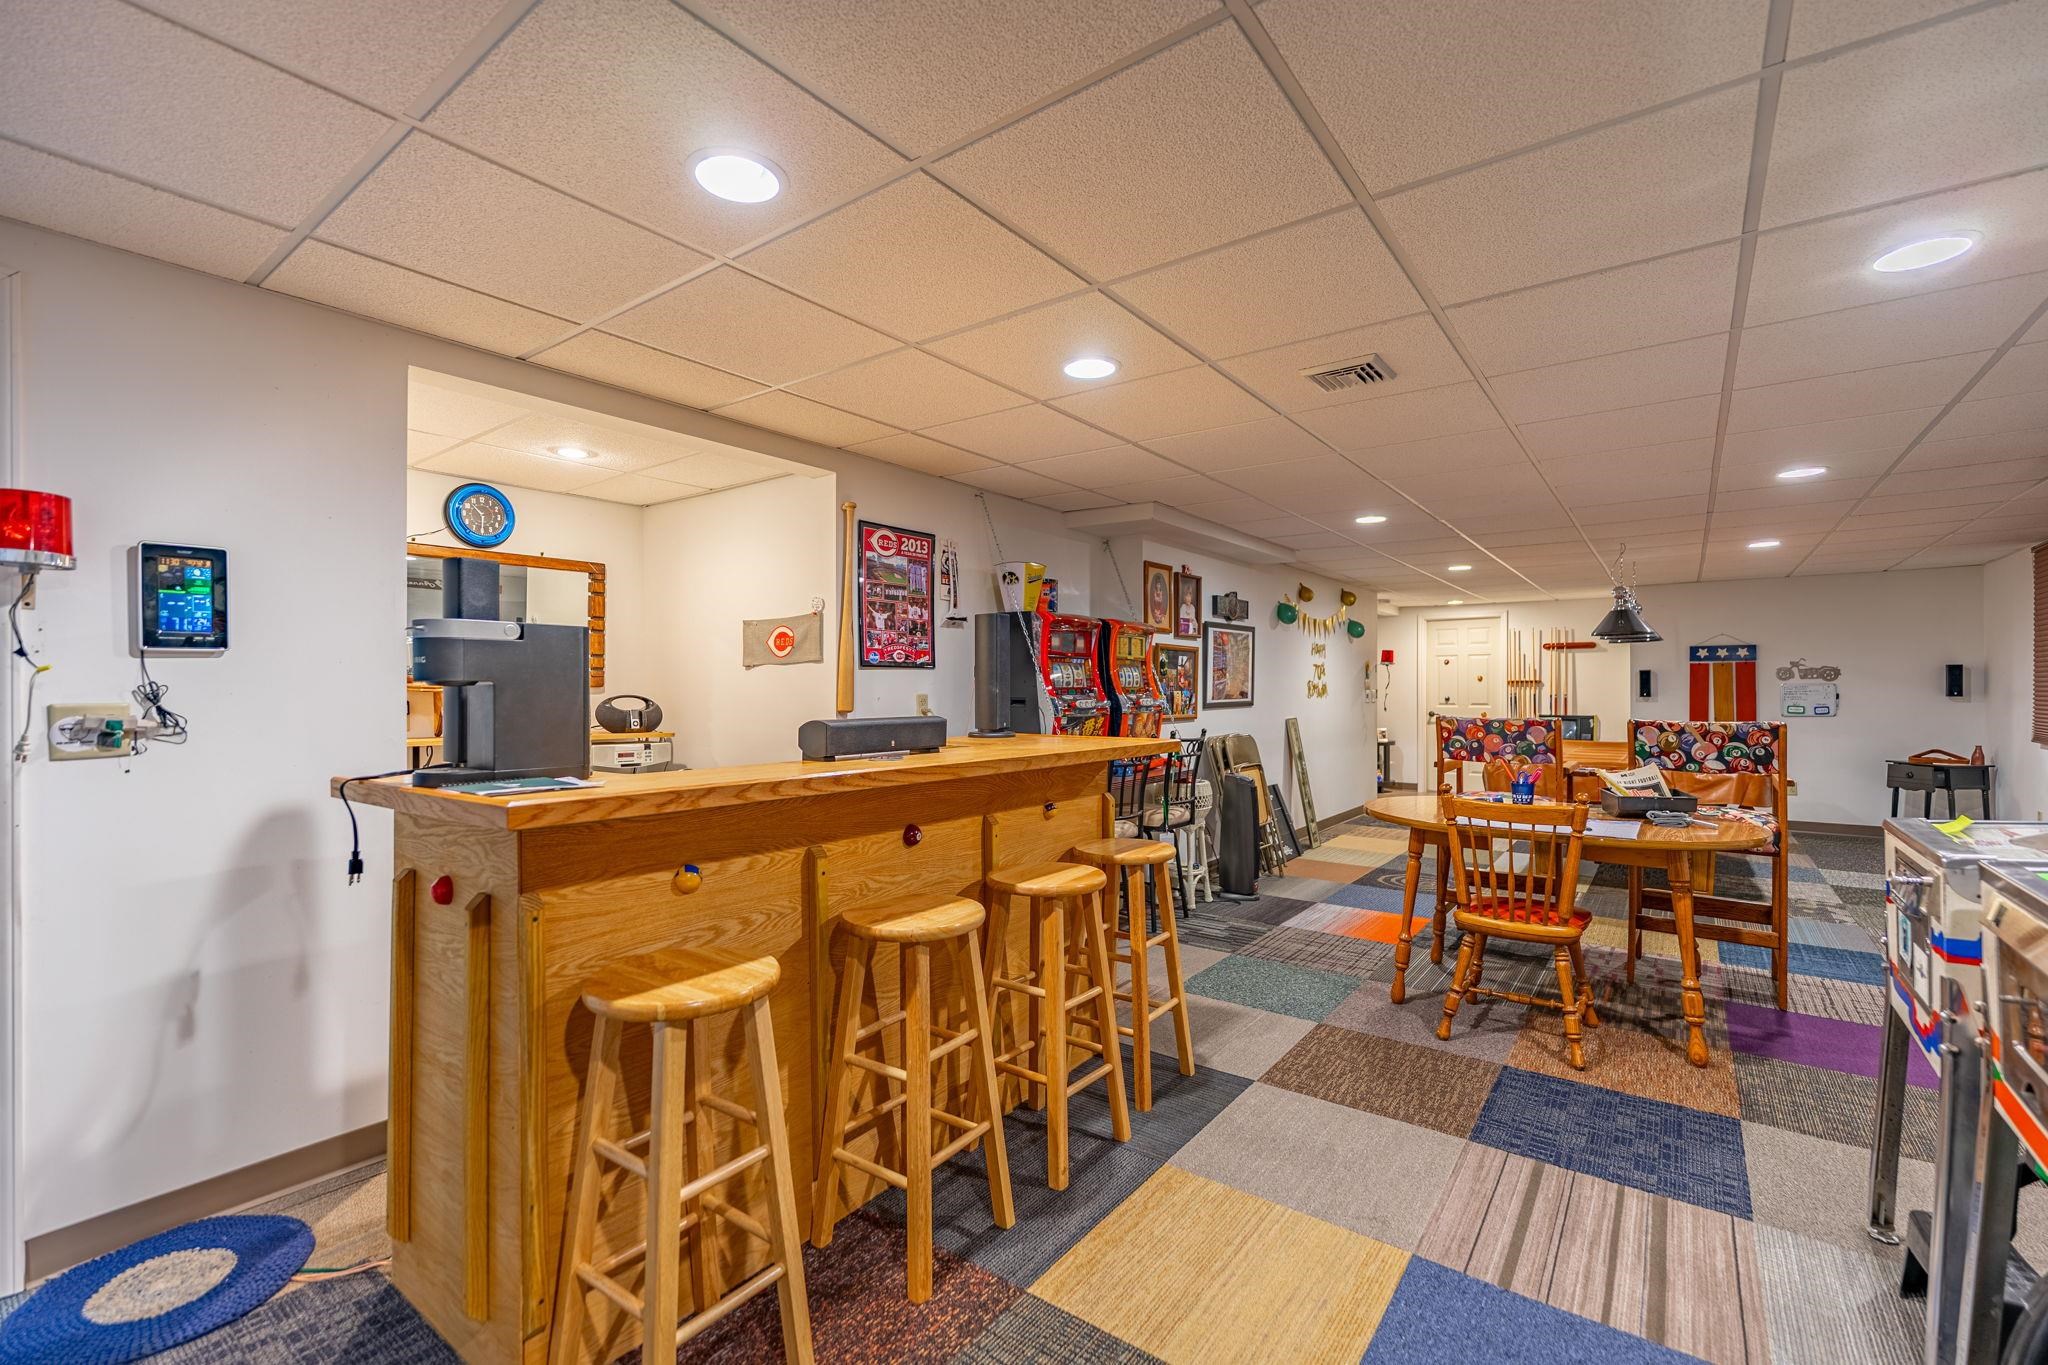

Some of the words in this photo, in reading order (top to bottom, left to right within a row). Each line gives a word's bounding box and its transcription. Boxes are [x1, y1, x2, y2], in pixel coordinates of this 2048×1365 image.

[878, 539, 897, 549] REDS
[901, 537, 928, 555] 2013
[776, 638, 793, 646] REDS
[1637, 774, 1659, 784] FOOTBALL
